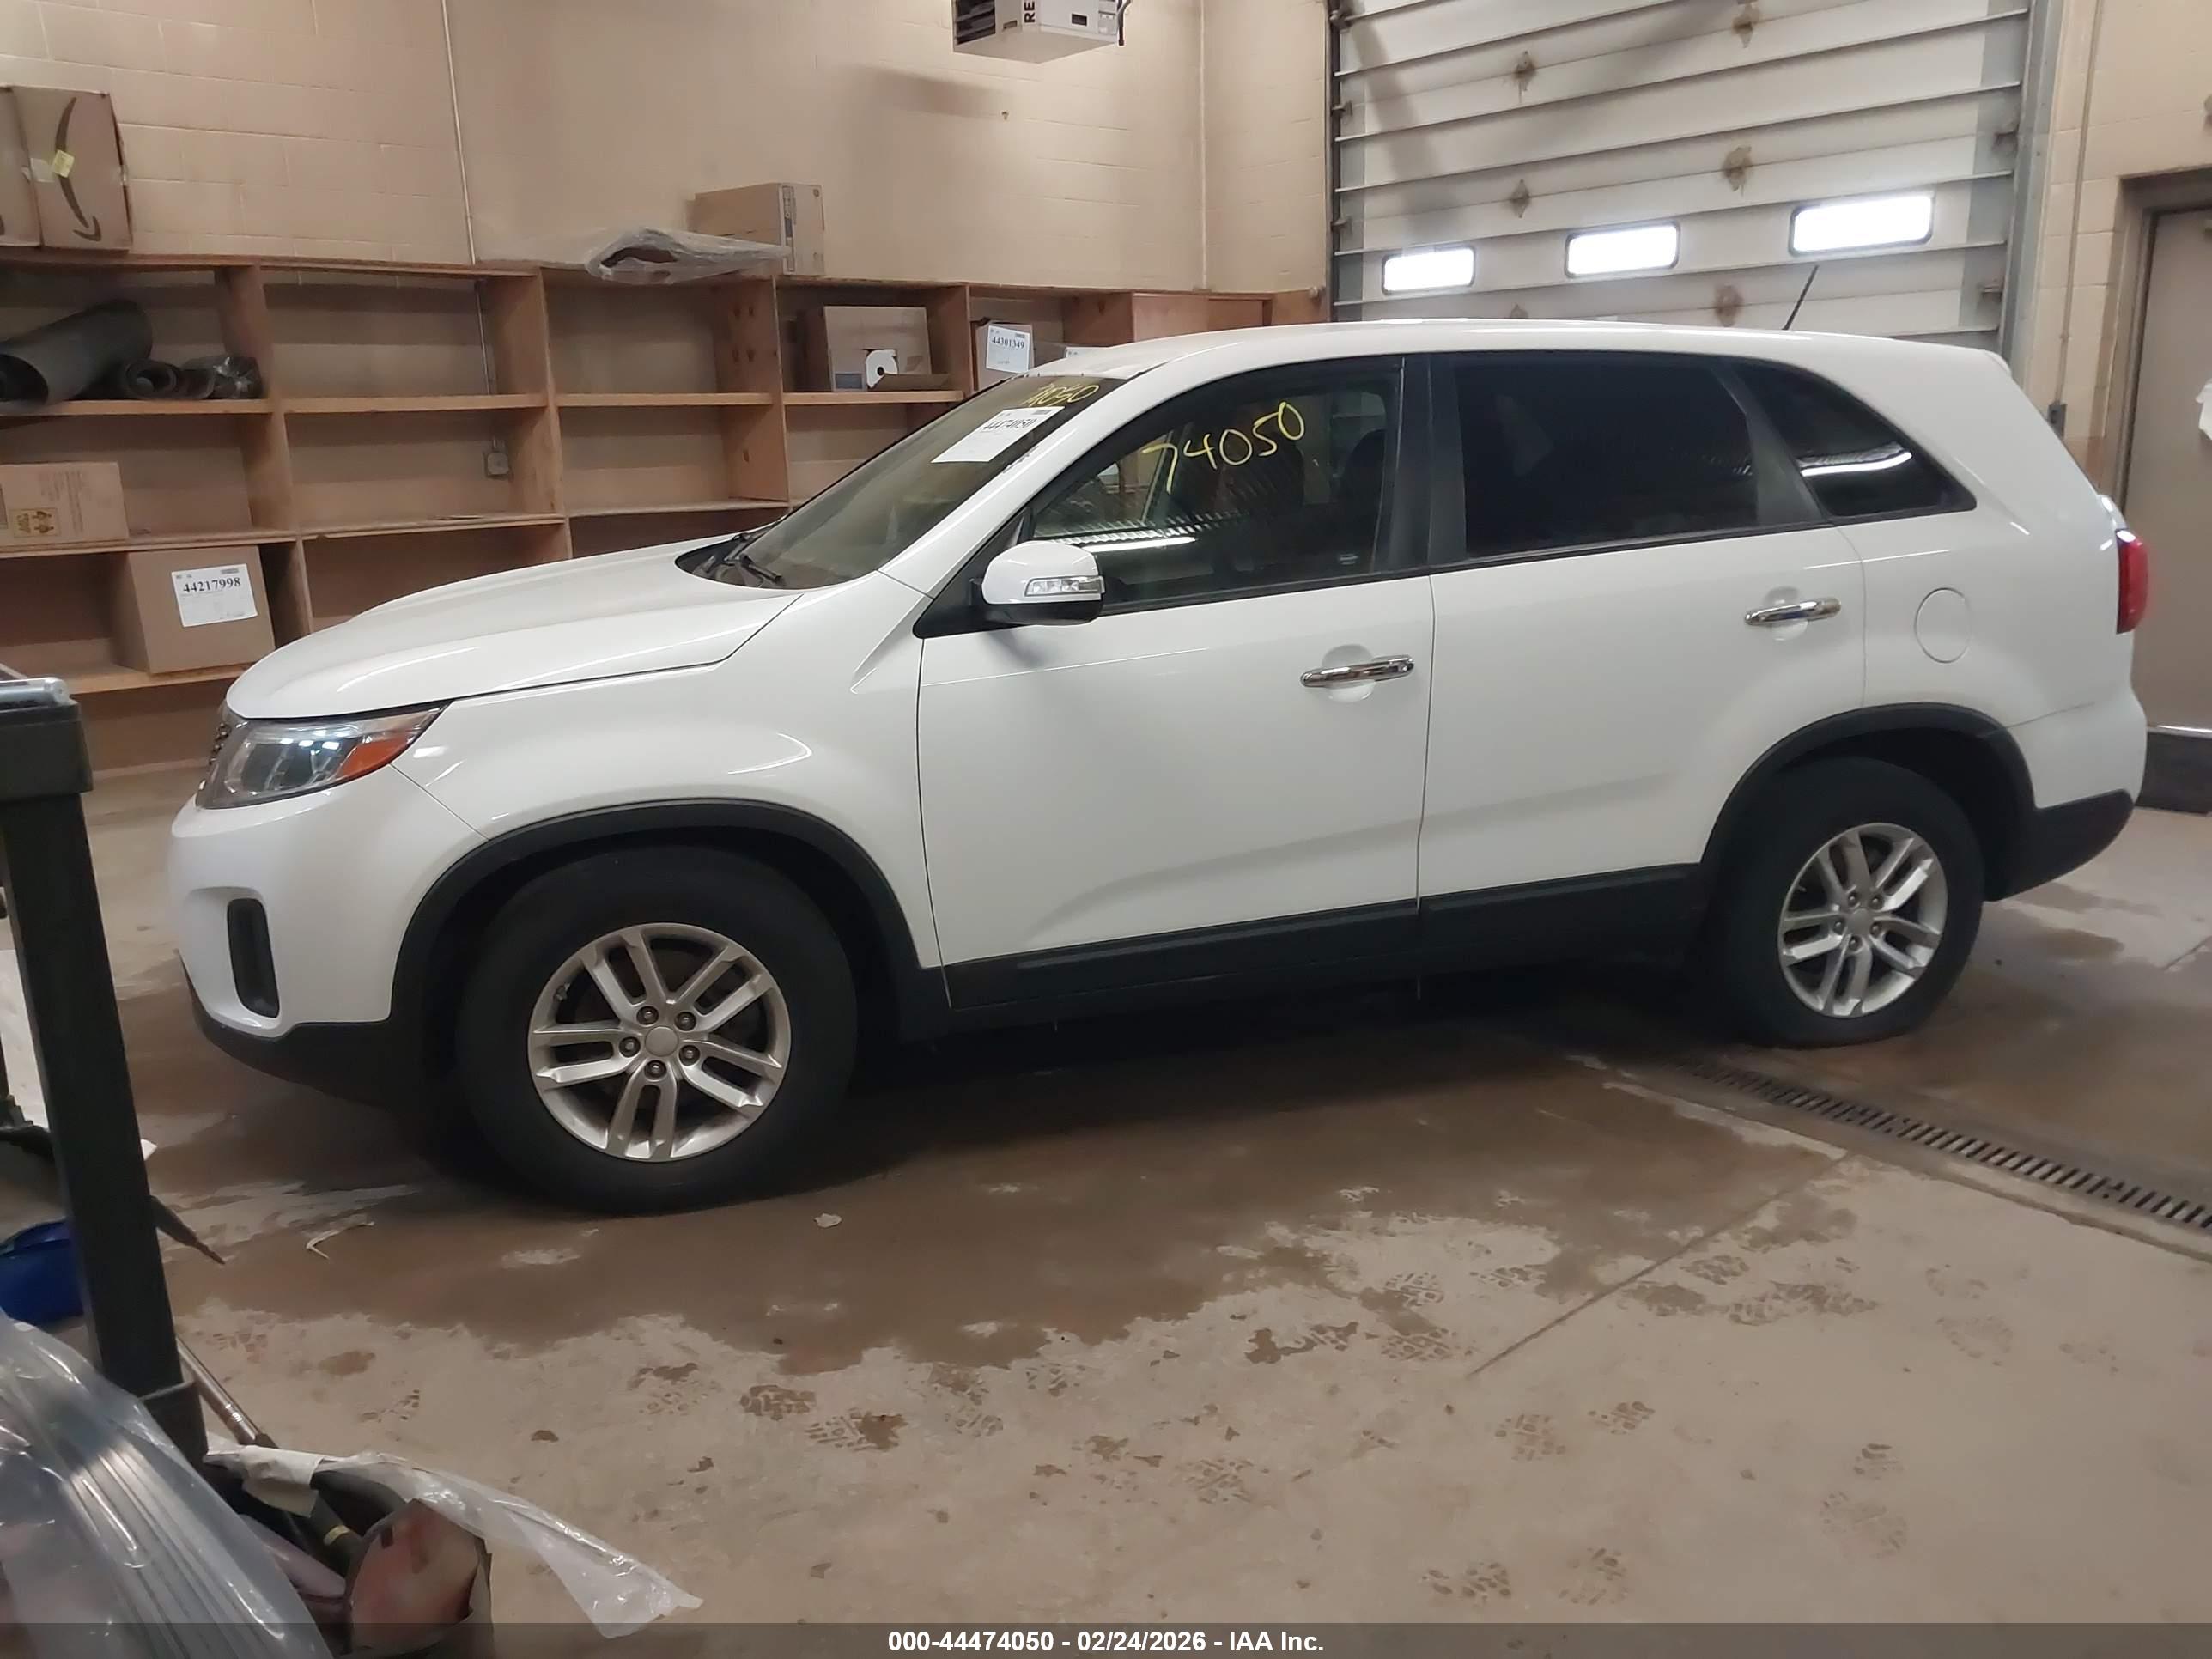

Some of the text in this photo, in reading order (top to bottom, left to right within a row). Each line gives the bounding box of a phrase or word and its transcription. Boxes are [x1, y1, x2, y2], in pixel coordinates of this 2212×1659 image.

[992, 337, 1024, 349] 44301349
[1142, 402, 1304, 495] 74050
[183, 577, 241, 592] 44217998
